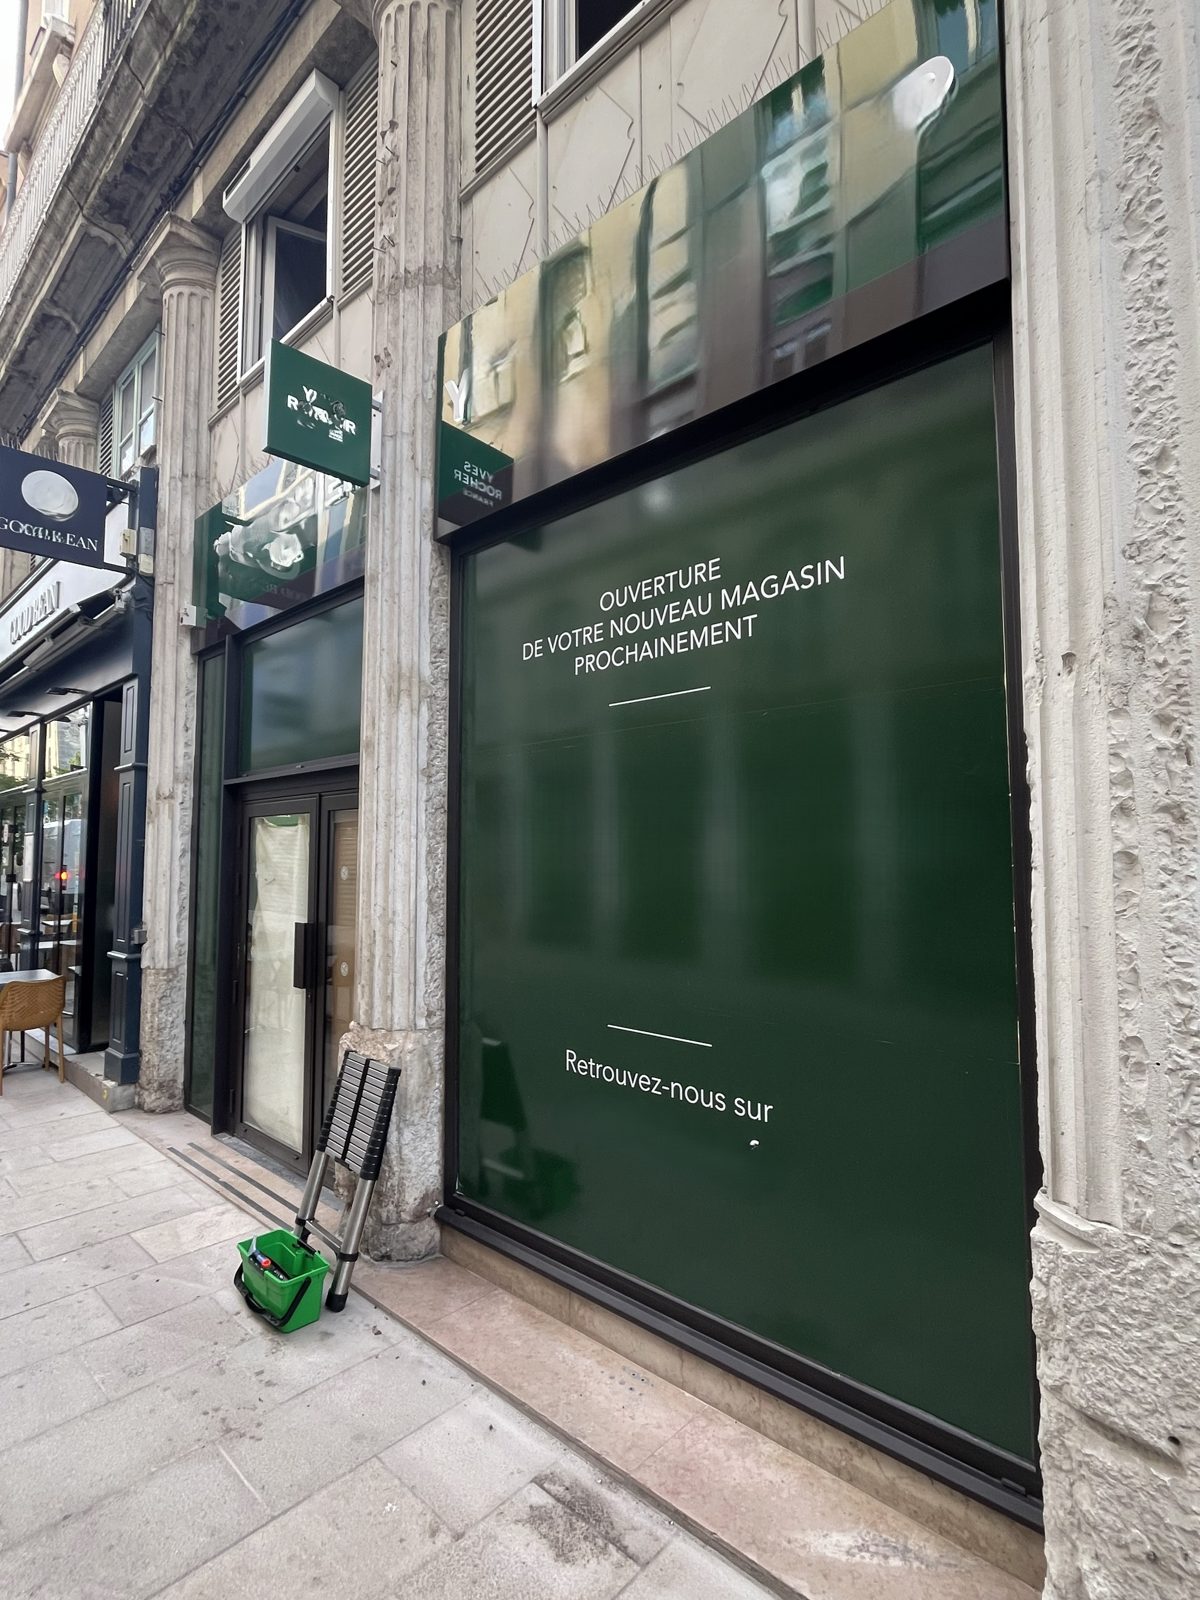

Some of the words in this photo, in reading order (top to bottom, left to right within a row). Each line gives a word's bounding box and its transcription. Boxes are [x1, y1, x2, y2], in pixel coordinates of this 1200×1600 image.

[522, 639, 544, 661] DE
[547, 622, 604, 654] VOTRE
[610, 592, 712, 639] NOUVEAU
[721, 556, 845, 611] MAGASIN
[599, 557, 722, 612] OUVERTURE
[574, 613, 758, 676] PROCHAINEMENT
[565, 1049, 727, 1112] Retrouvez-nous
[734, 1097, 774, 1123] sur
